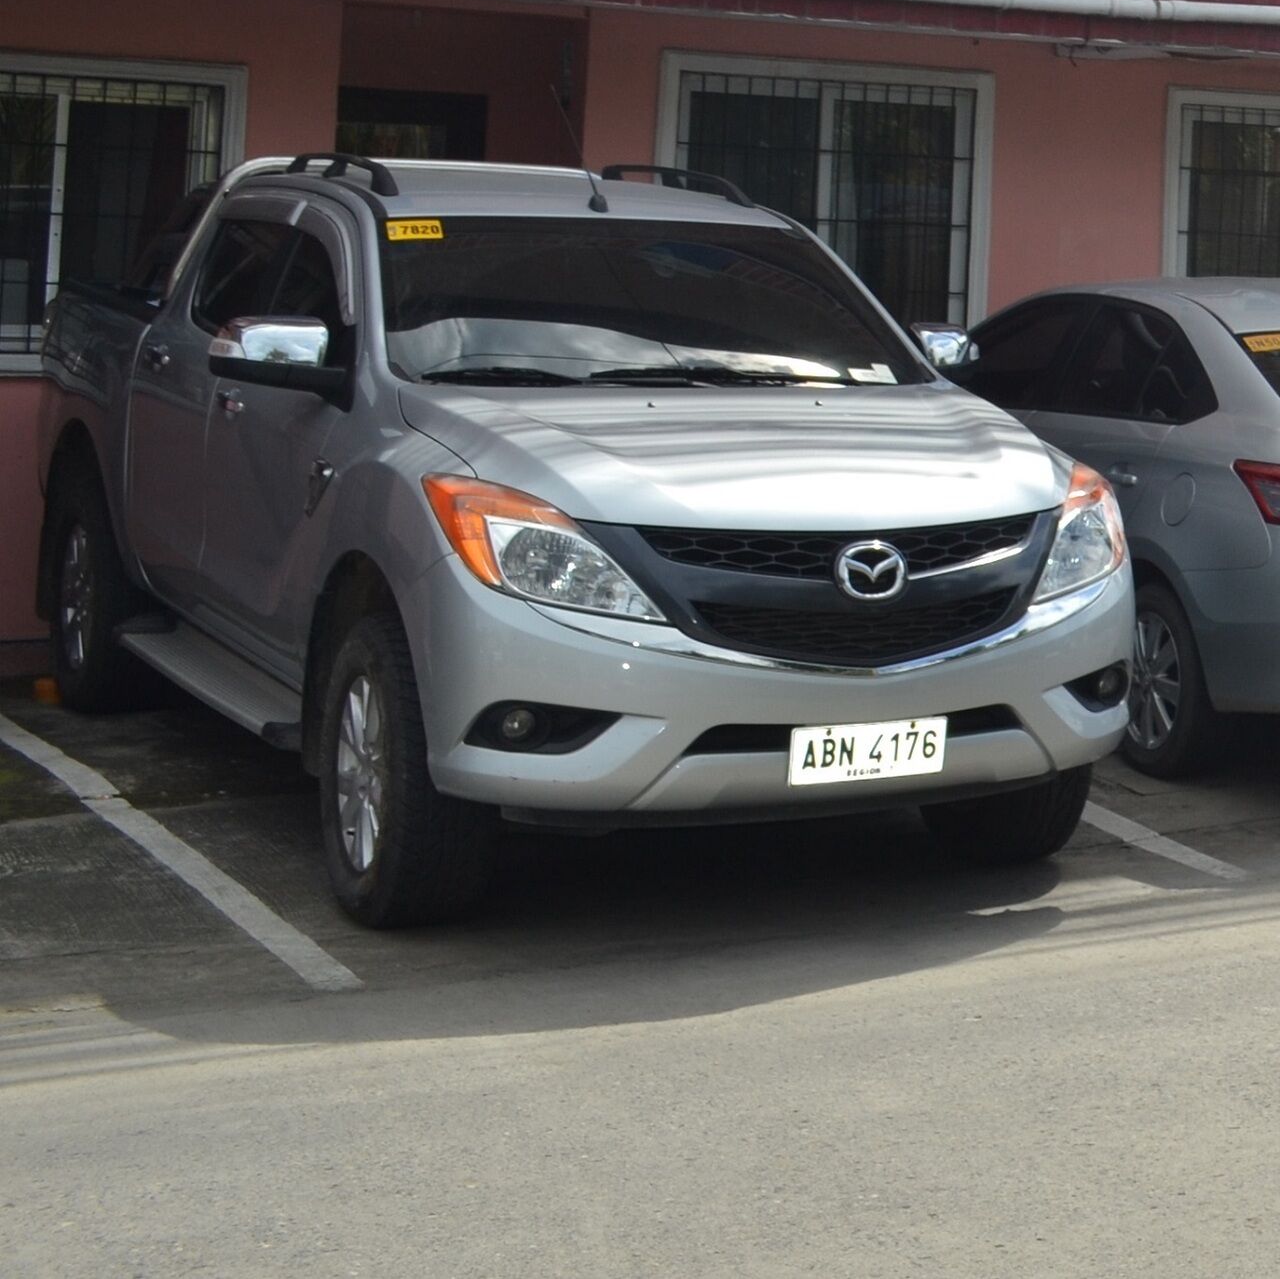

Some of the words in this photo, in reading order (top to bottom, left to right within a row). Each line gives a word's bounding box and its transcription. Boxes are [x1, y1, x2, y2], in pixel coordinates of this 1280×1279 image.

[399, 224, 440, 235] 7820
[802, 738, 855, 769] ABN
[869, 730, 937, 763] 4176
